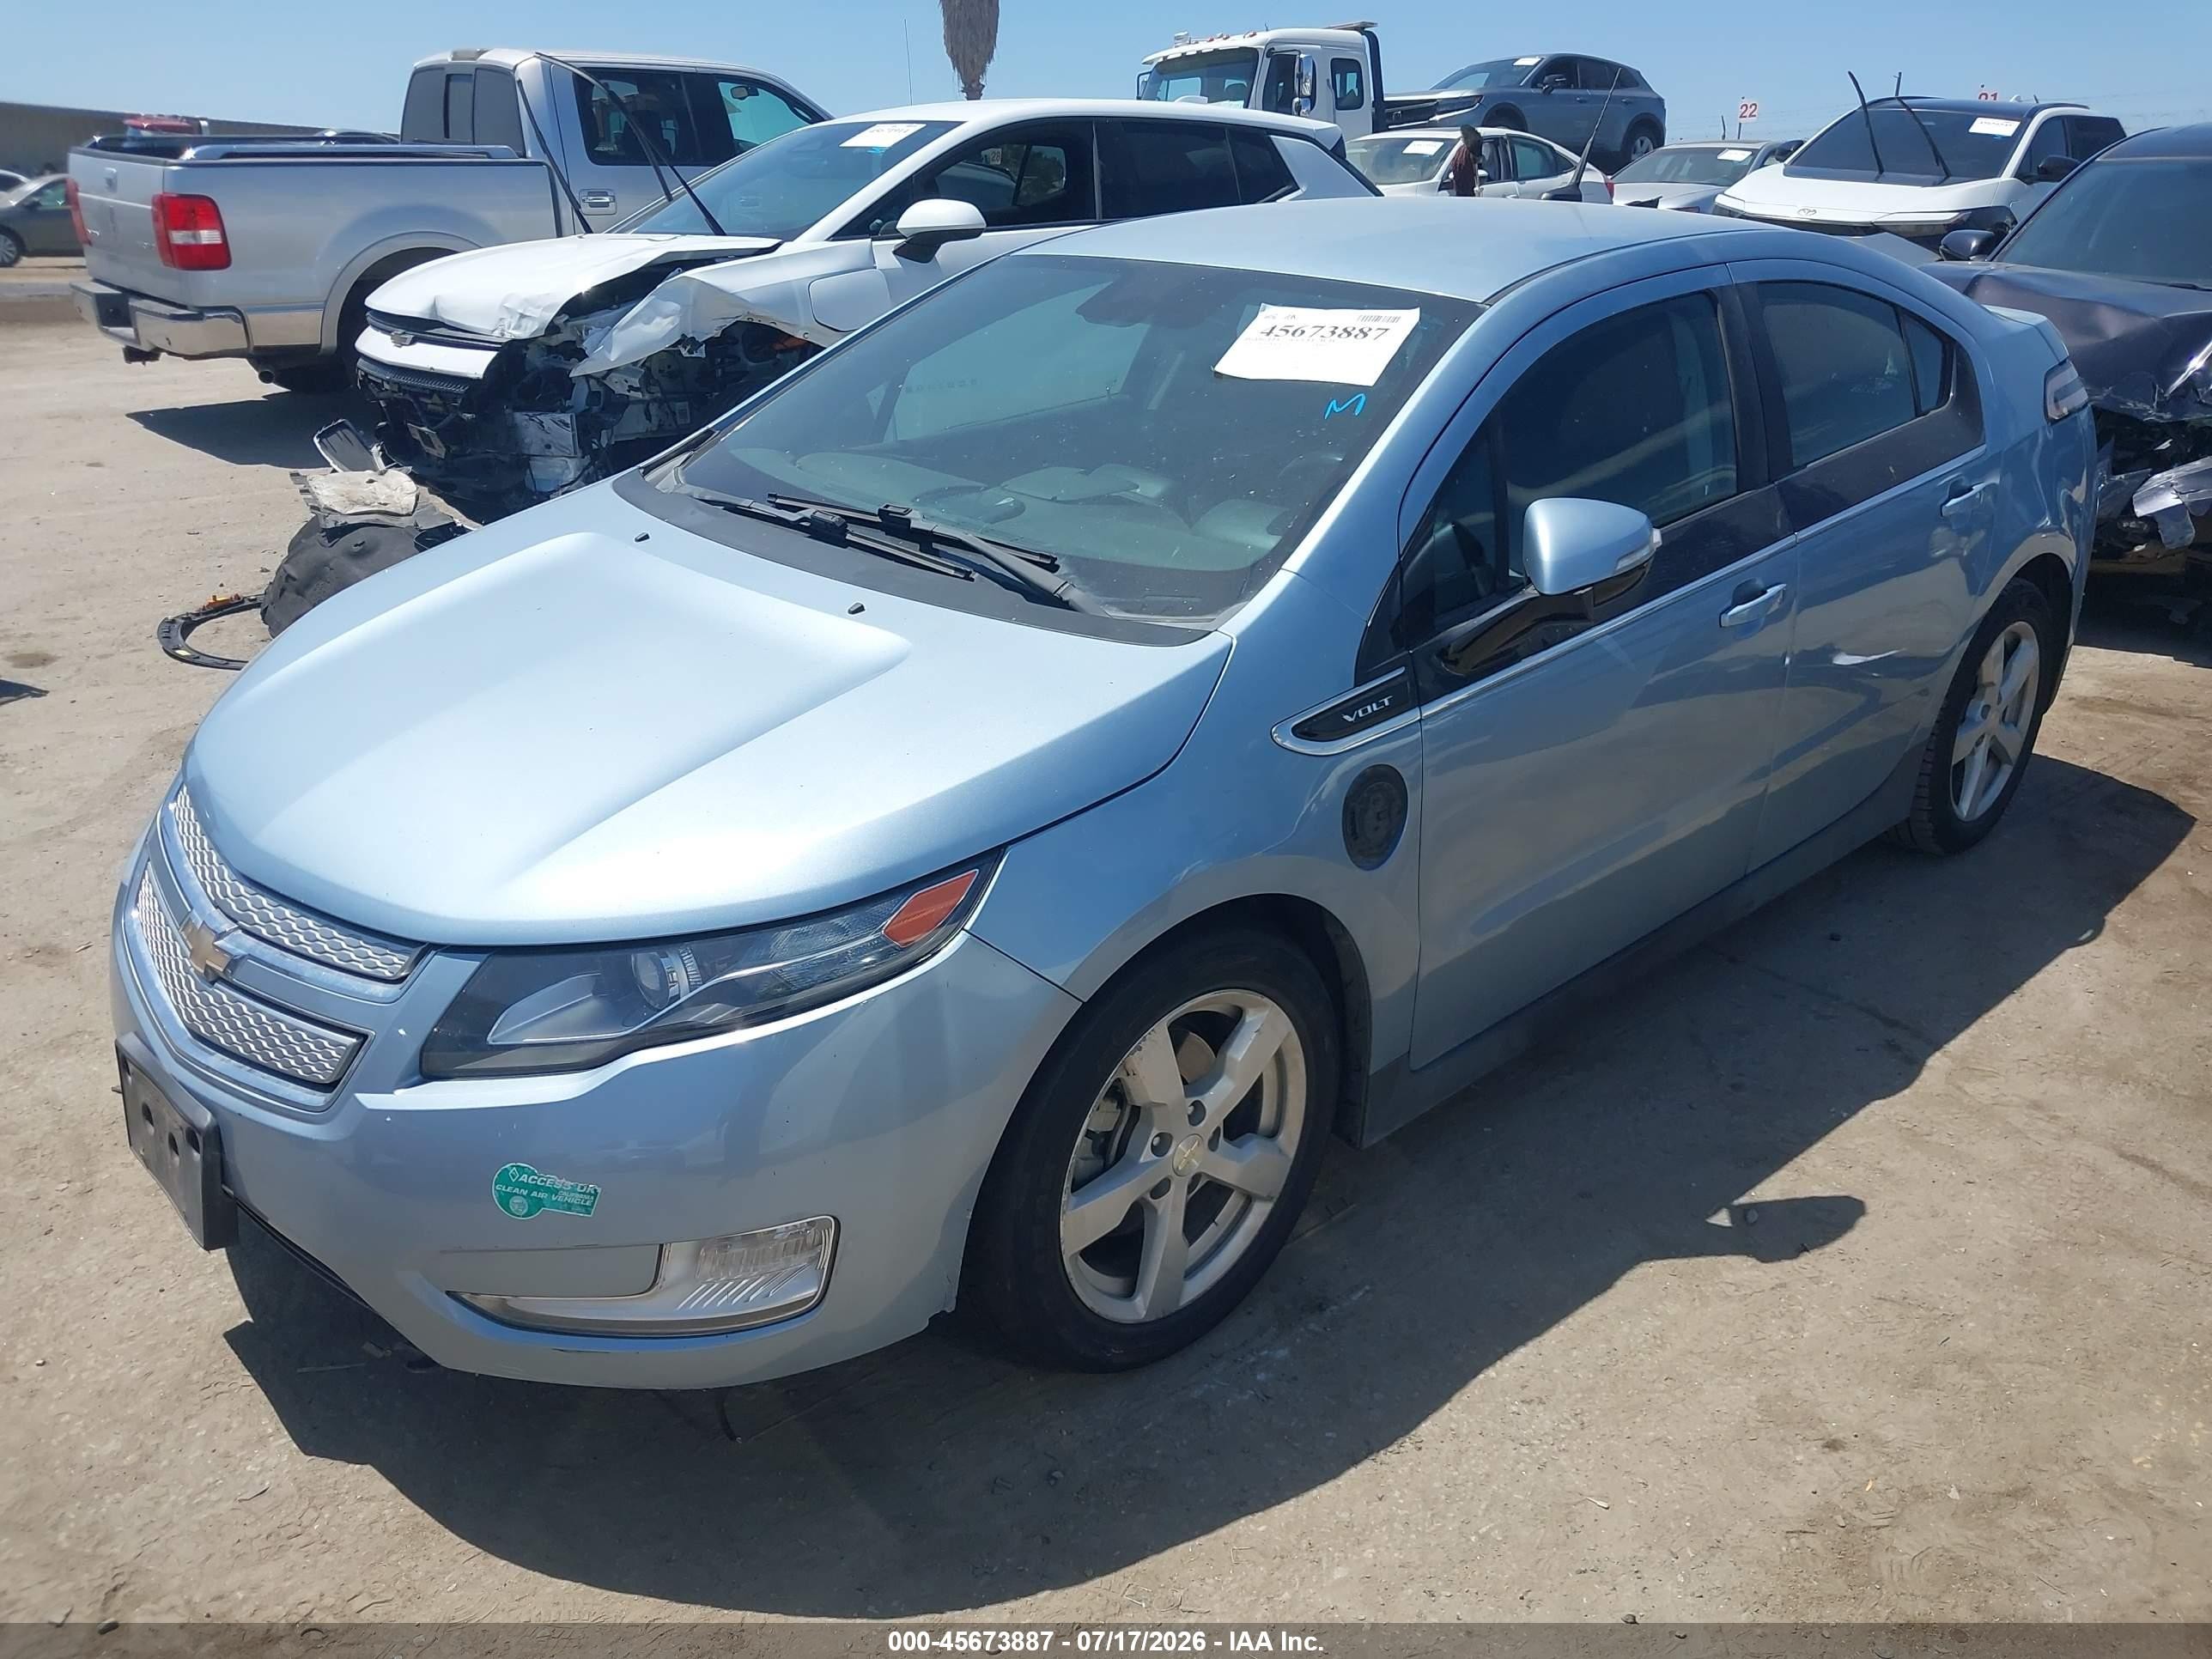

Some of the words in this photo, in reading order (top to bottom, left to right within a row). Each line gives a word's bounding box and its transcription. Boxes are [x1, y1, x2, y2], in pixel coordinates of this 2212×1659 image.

[1739, 103, 1757, 118] 22
[1261, 325, 1390, 341] 45673887
[1324, 393, 1366, 420] M
[1342, 696, 1393, 722] VOLT
[519, 1174, 573, 1190] ACCESS
[495, 1184, 528, 1195] CLEAN
[551, 1194, 593, 1206] VEHICLE
